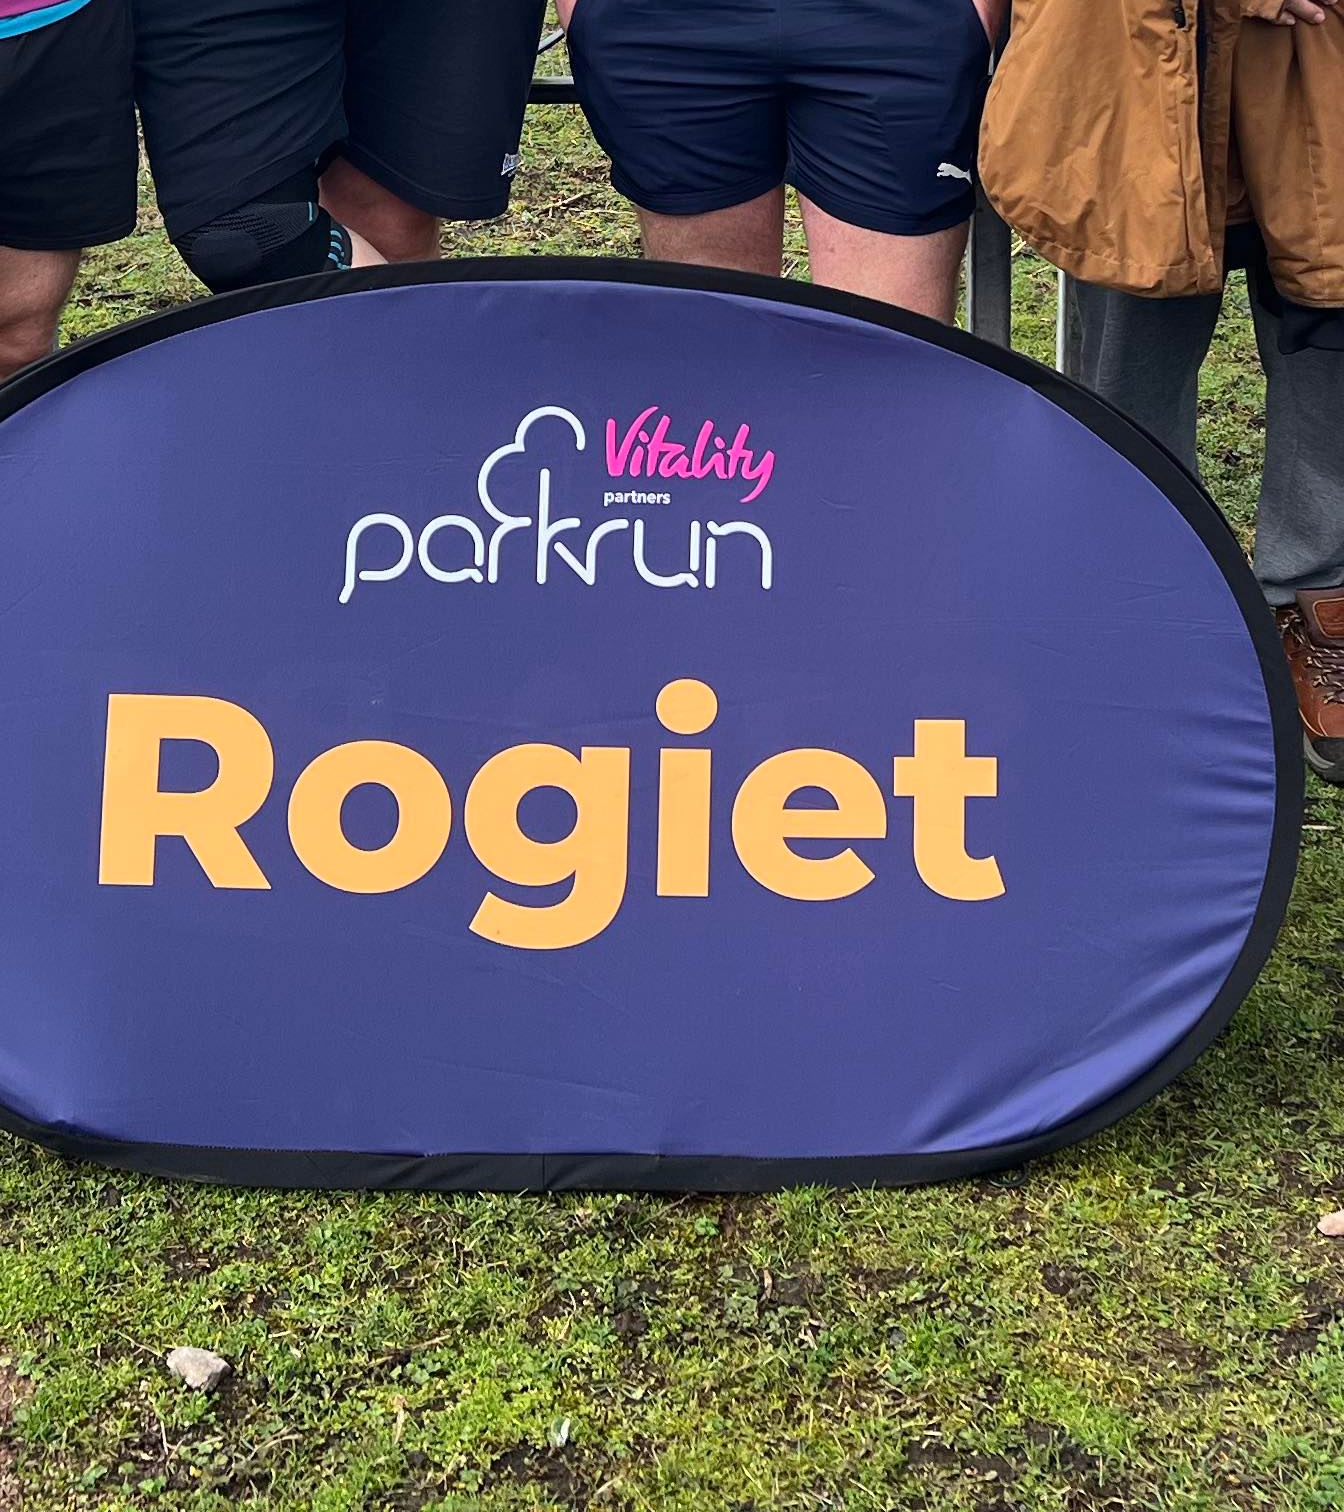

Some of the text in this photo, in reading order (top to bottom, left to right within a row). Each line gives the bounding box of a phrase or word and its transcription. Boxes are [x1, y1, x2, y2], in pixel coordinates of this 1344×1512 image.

[338, 405, 773, 604] parkrun
[603, 490, 672, 507] partners
[605, 406, 775, 504] Vitality
[97, 678, 1007, 951] Rogiet
